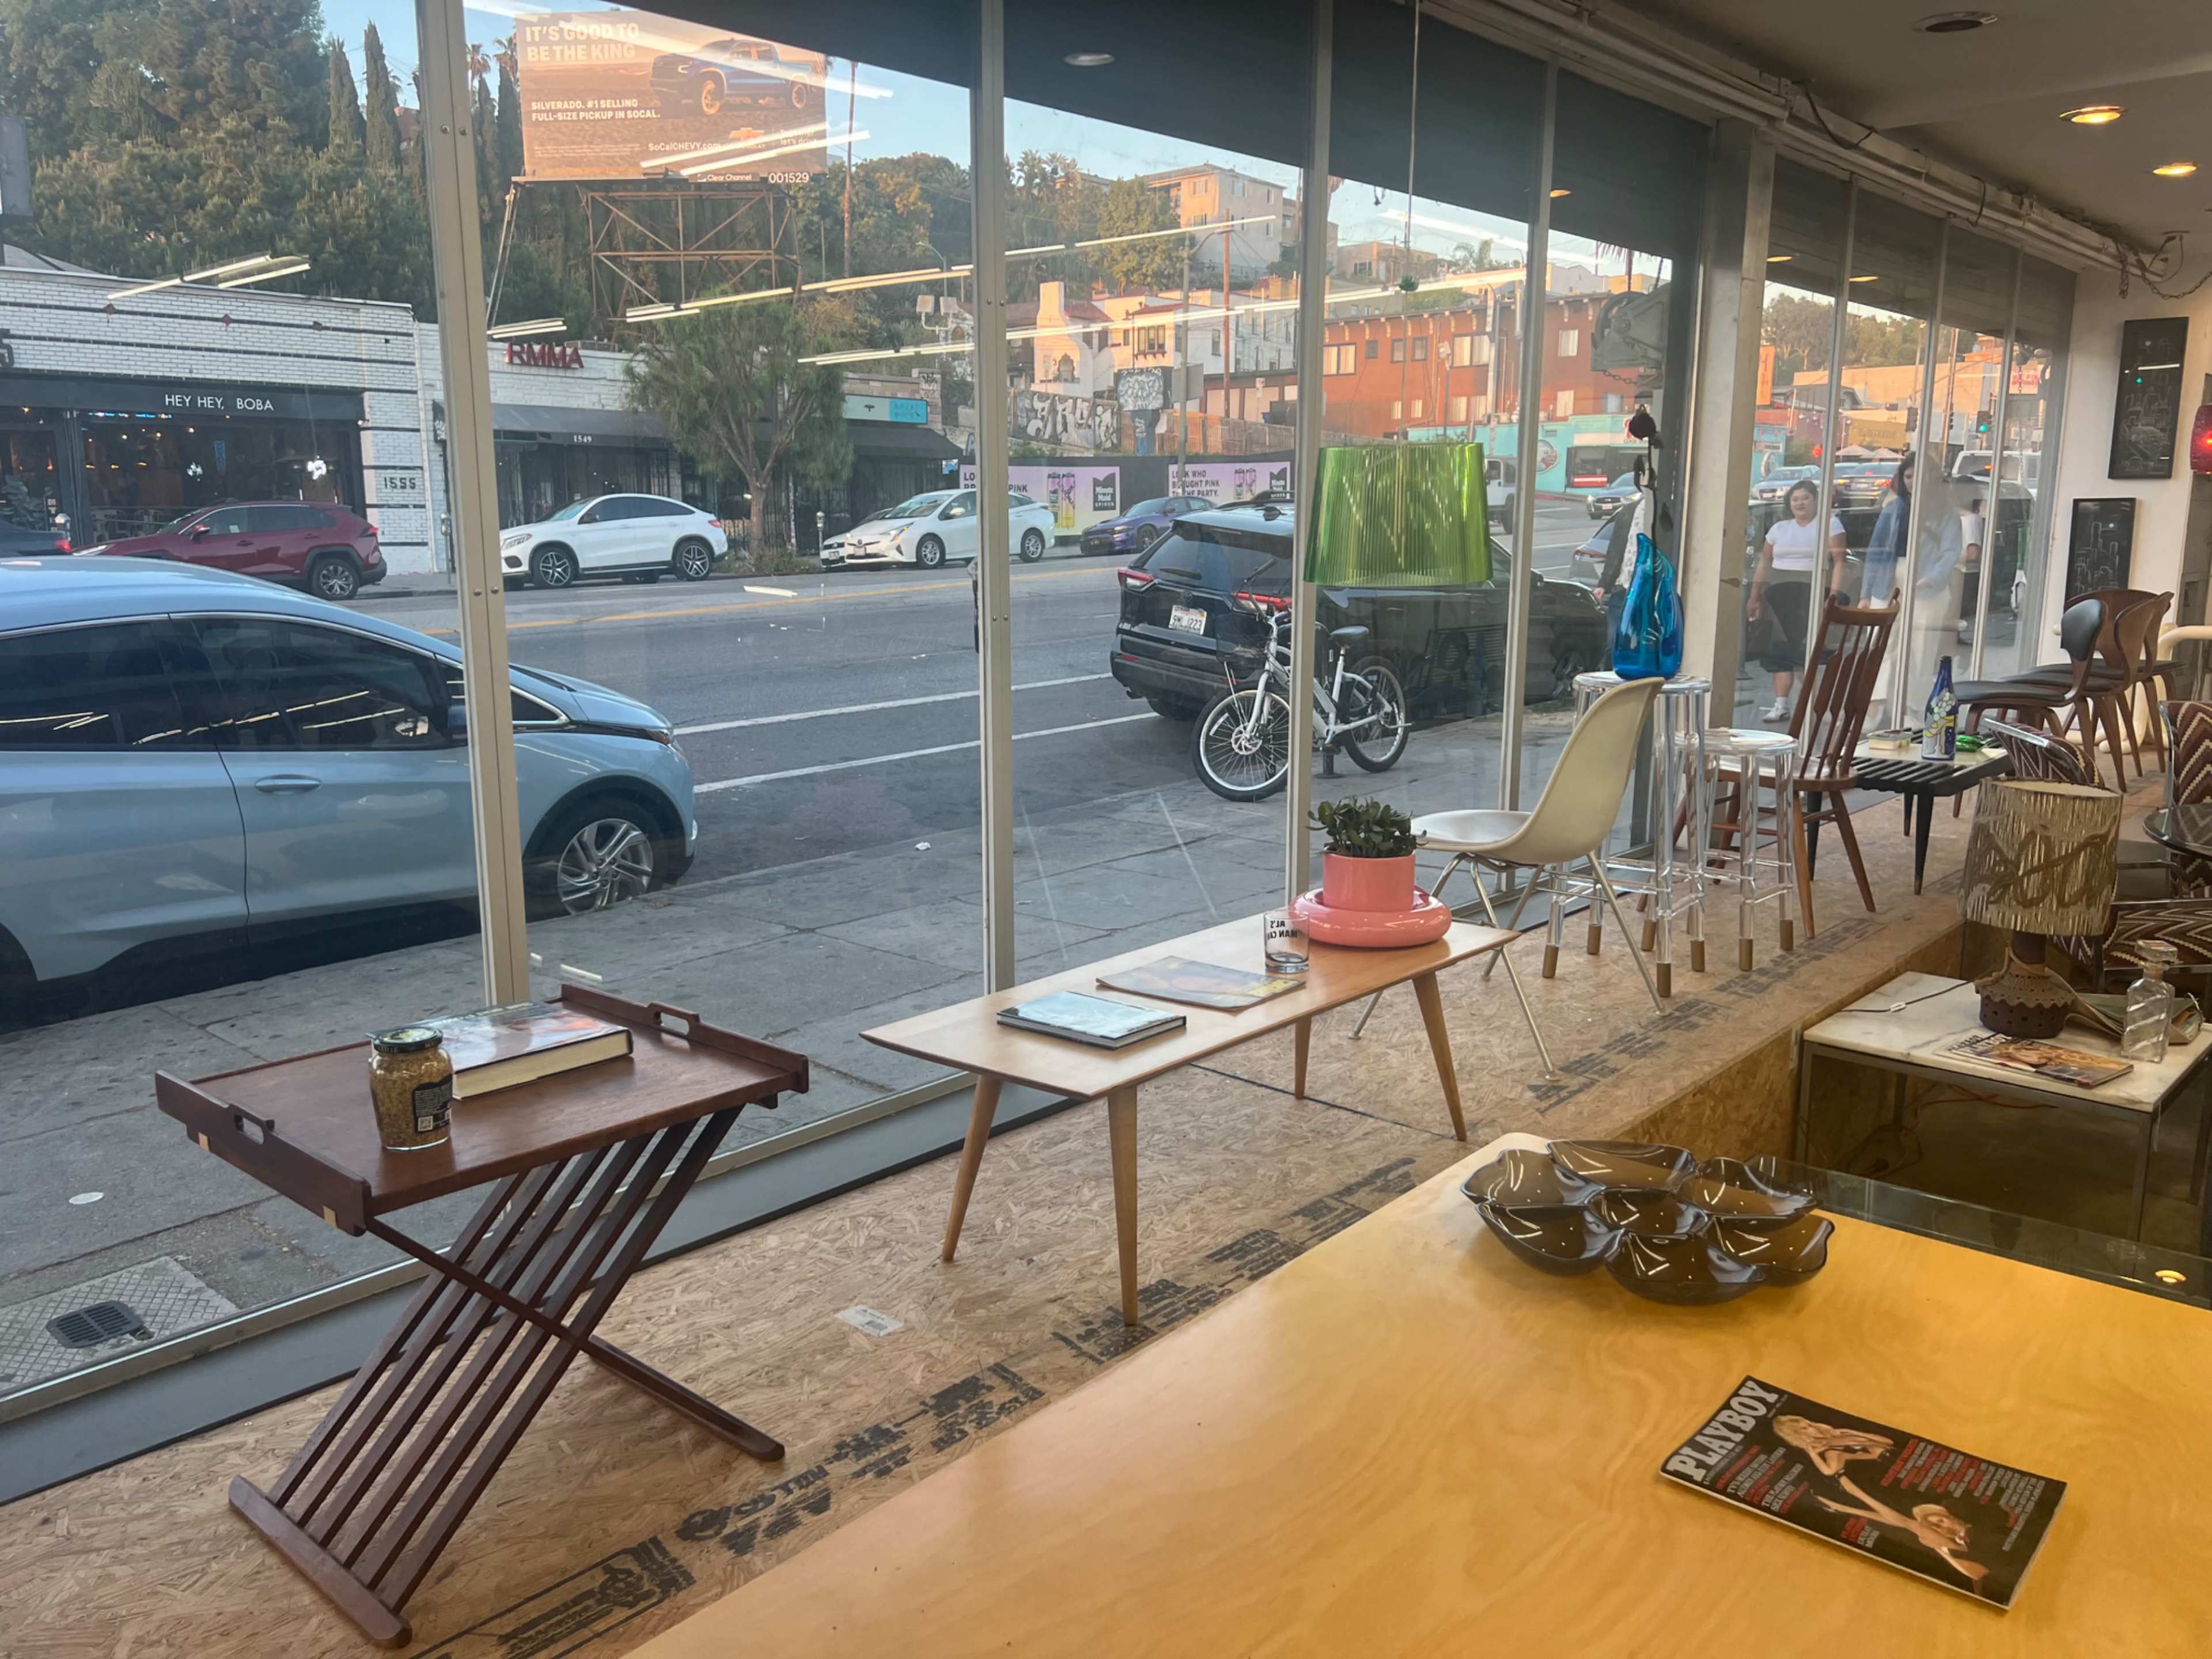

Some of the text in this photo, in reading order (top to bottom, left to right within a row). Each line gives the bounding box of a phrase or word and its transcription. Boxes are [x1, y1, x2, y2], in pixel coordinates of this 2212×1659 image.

[525, 23, 639, 42] IT'S GOOD TO
[527, 44, 636, 62] BE THE KING
[531, 99, 638, 110] SILVERADO. #1 SELLING
[532, 109, 661, 122] FULL-SIZE PICKUP IN SOCAL.
[769, 173, 809, 183] 001529
[165, 394, 274, 411] HEY HEY, BOBA
[573, 435, 592, 443] 1549
[384, 477, 416, 489] 1555
[1008, 484, 1028, 493] PINK
[1205, 479, 1219, 487] PINK
[1665, 1380, 1779, 1483] PLAYBOY
